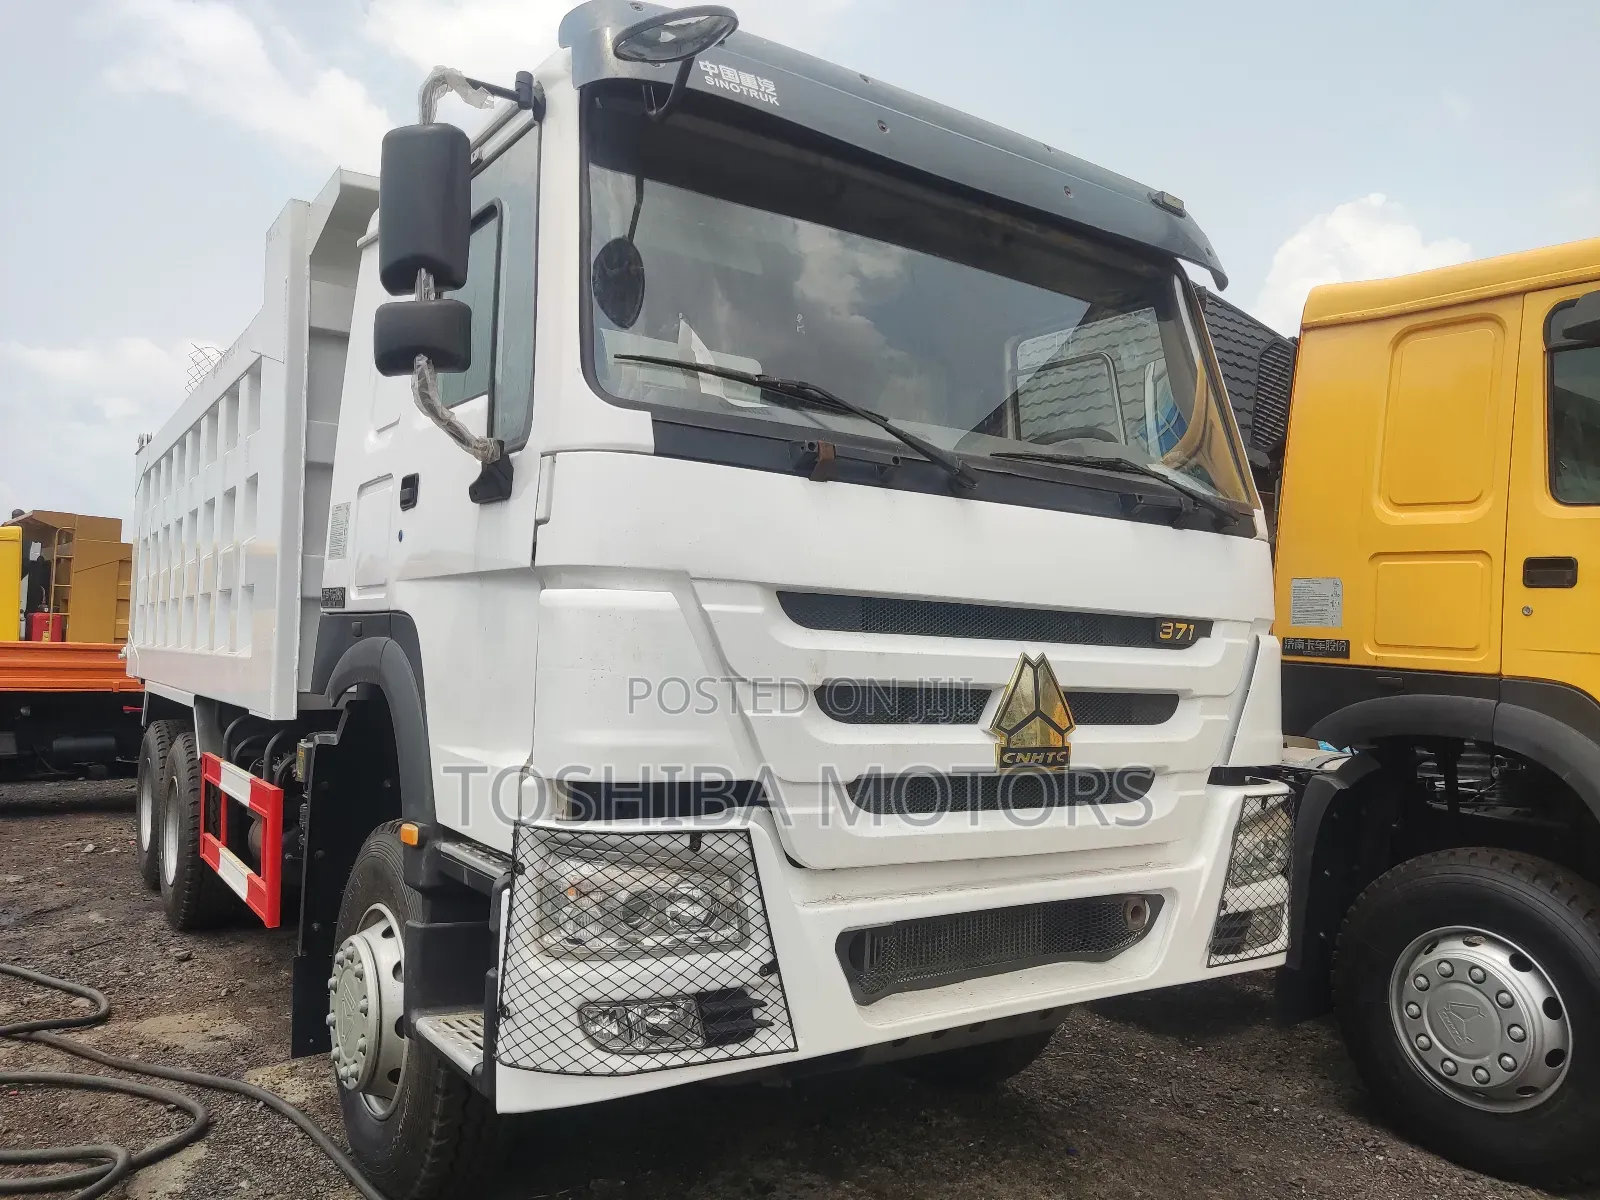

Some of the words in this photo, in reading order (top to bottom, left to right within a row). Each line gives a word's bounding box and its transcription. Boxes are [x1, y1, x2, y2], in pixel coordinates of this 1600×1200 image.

[704, 75, 780, 106] SINOTRUK
[1159, 621, 1195, 641] 371
[1002, 751, 1067, 764] CNHTC
